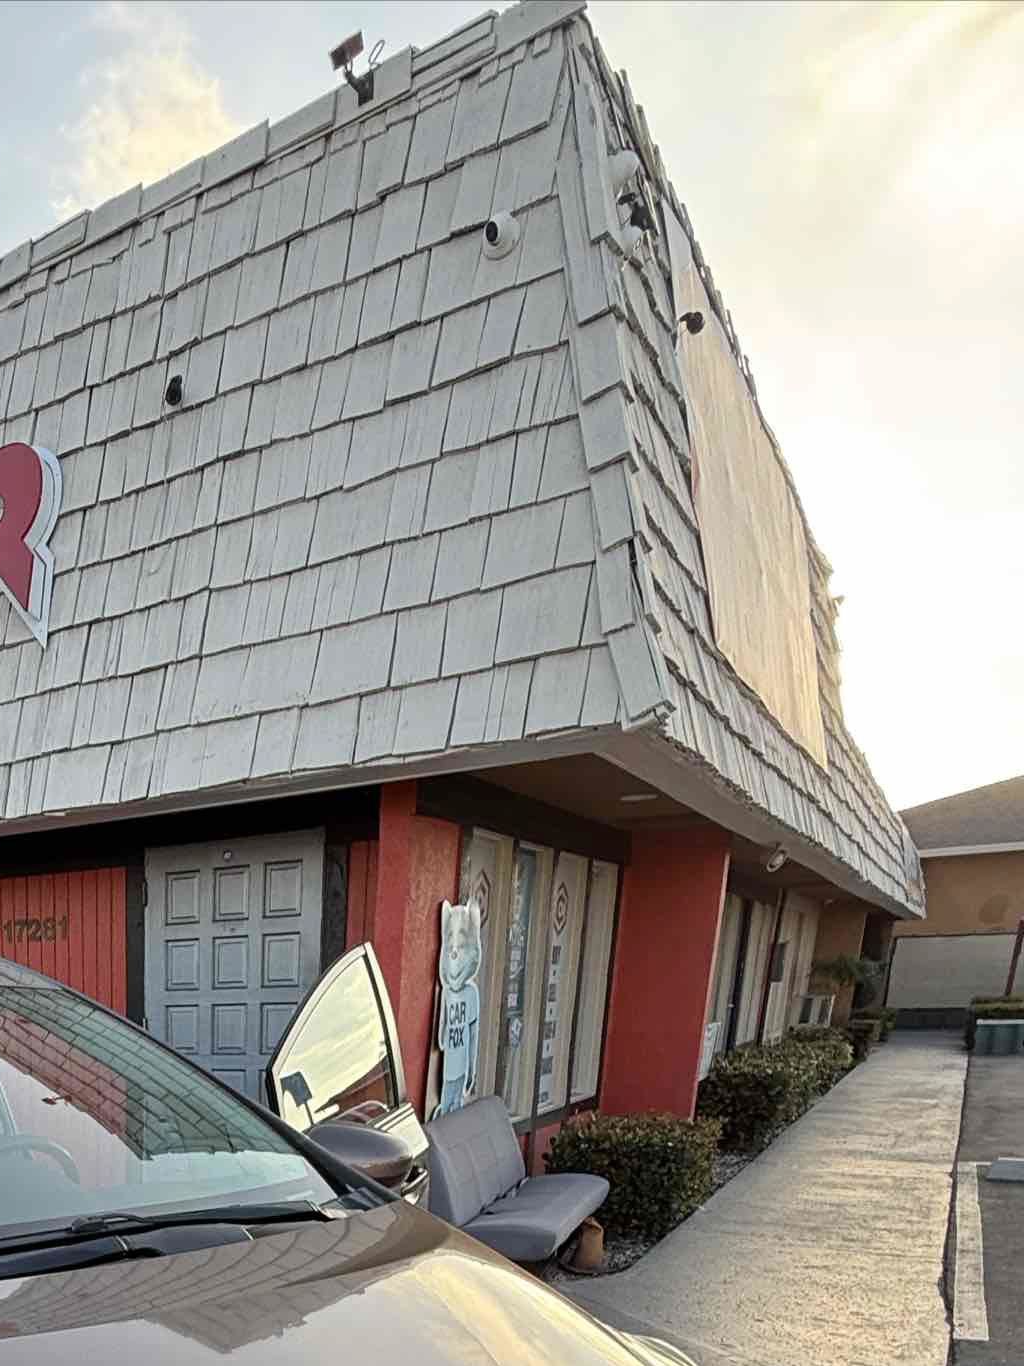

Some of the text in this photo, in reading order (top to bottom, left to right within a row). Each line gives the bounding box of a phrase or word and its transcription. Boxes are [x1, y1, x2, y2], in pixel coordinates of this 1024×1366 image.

[1, 913, 67, 944] 17281
[448, 1001, 466, 1025] CAR
[448, 1026, 465, 1048] FOX
